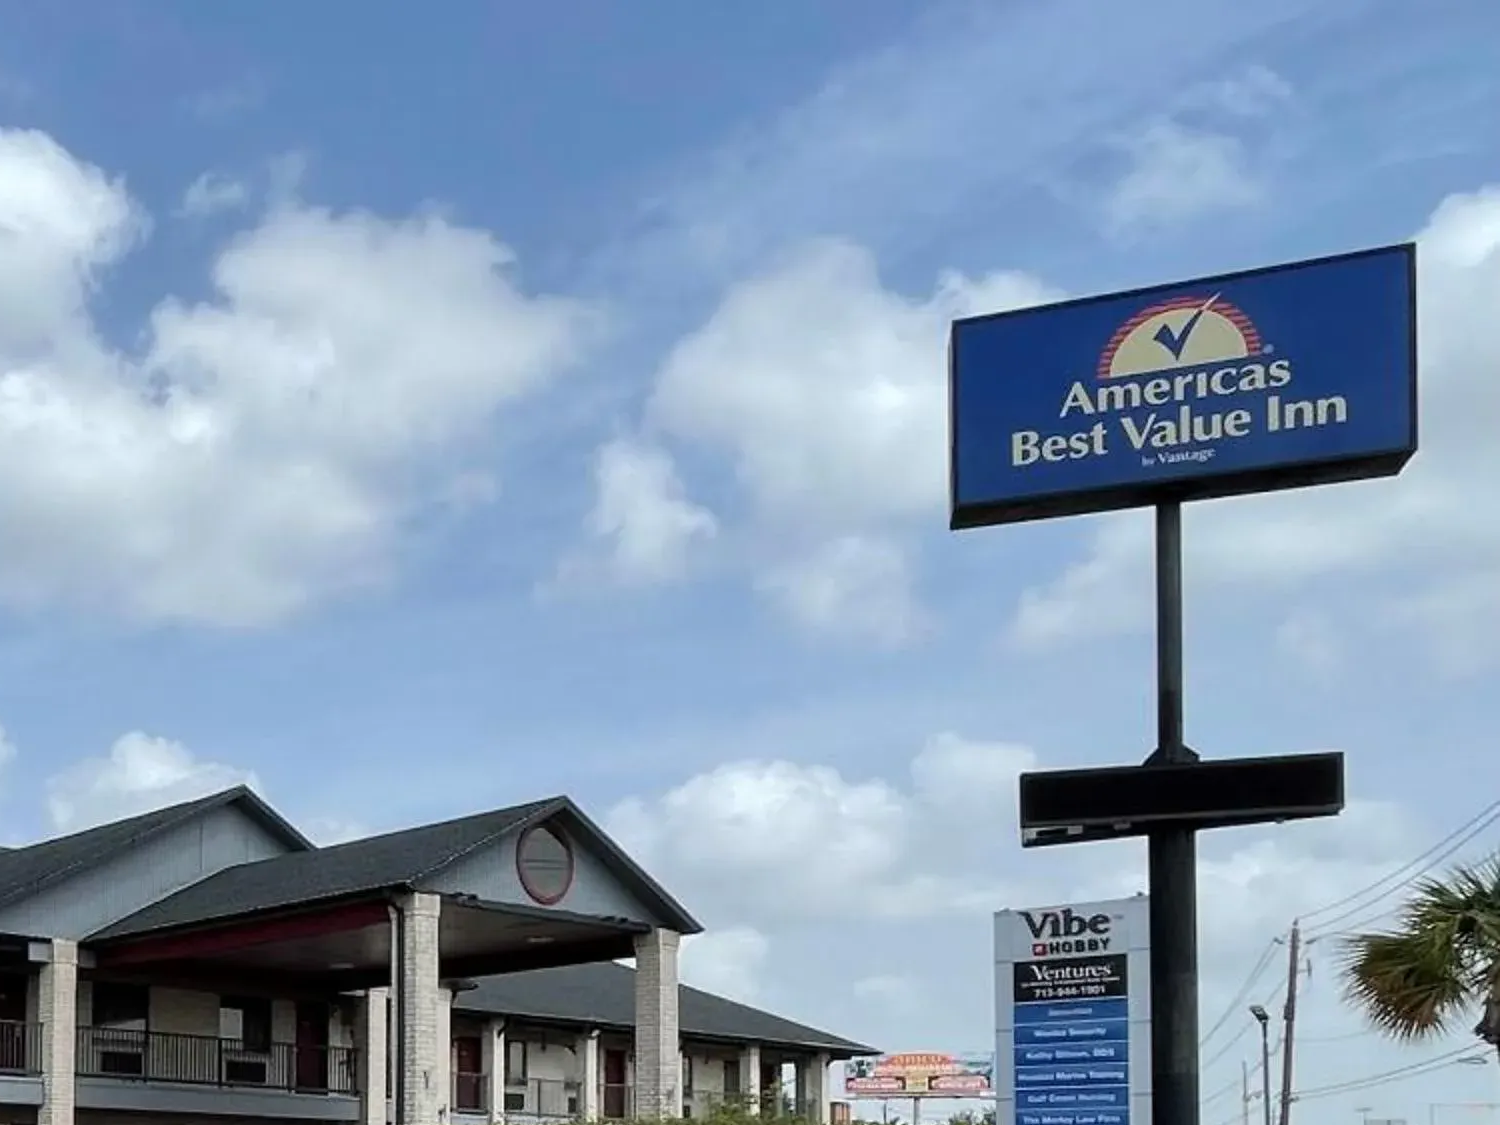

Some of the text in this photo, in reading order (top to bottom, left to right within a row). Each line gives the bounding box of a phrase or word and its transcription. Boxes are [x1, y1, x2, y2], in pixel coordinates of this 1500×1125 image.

[1059, 358, 1292, 418] Americas
[1011, 394, 1347, 467] Best Value Inn
[1157, 448, 1216, 464] Vantage
[1017, 908, 1111, 939] Vibe
[1049, 938, 1111, 955] HOBBY
[1029, 963, 1112, 981] Ventures
